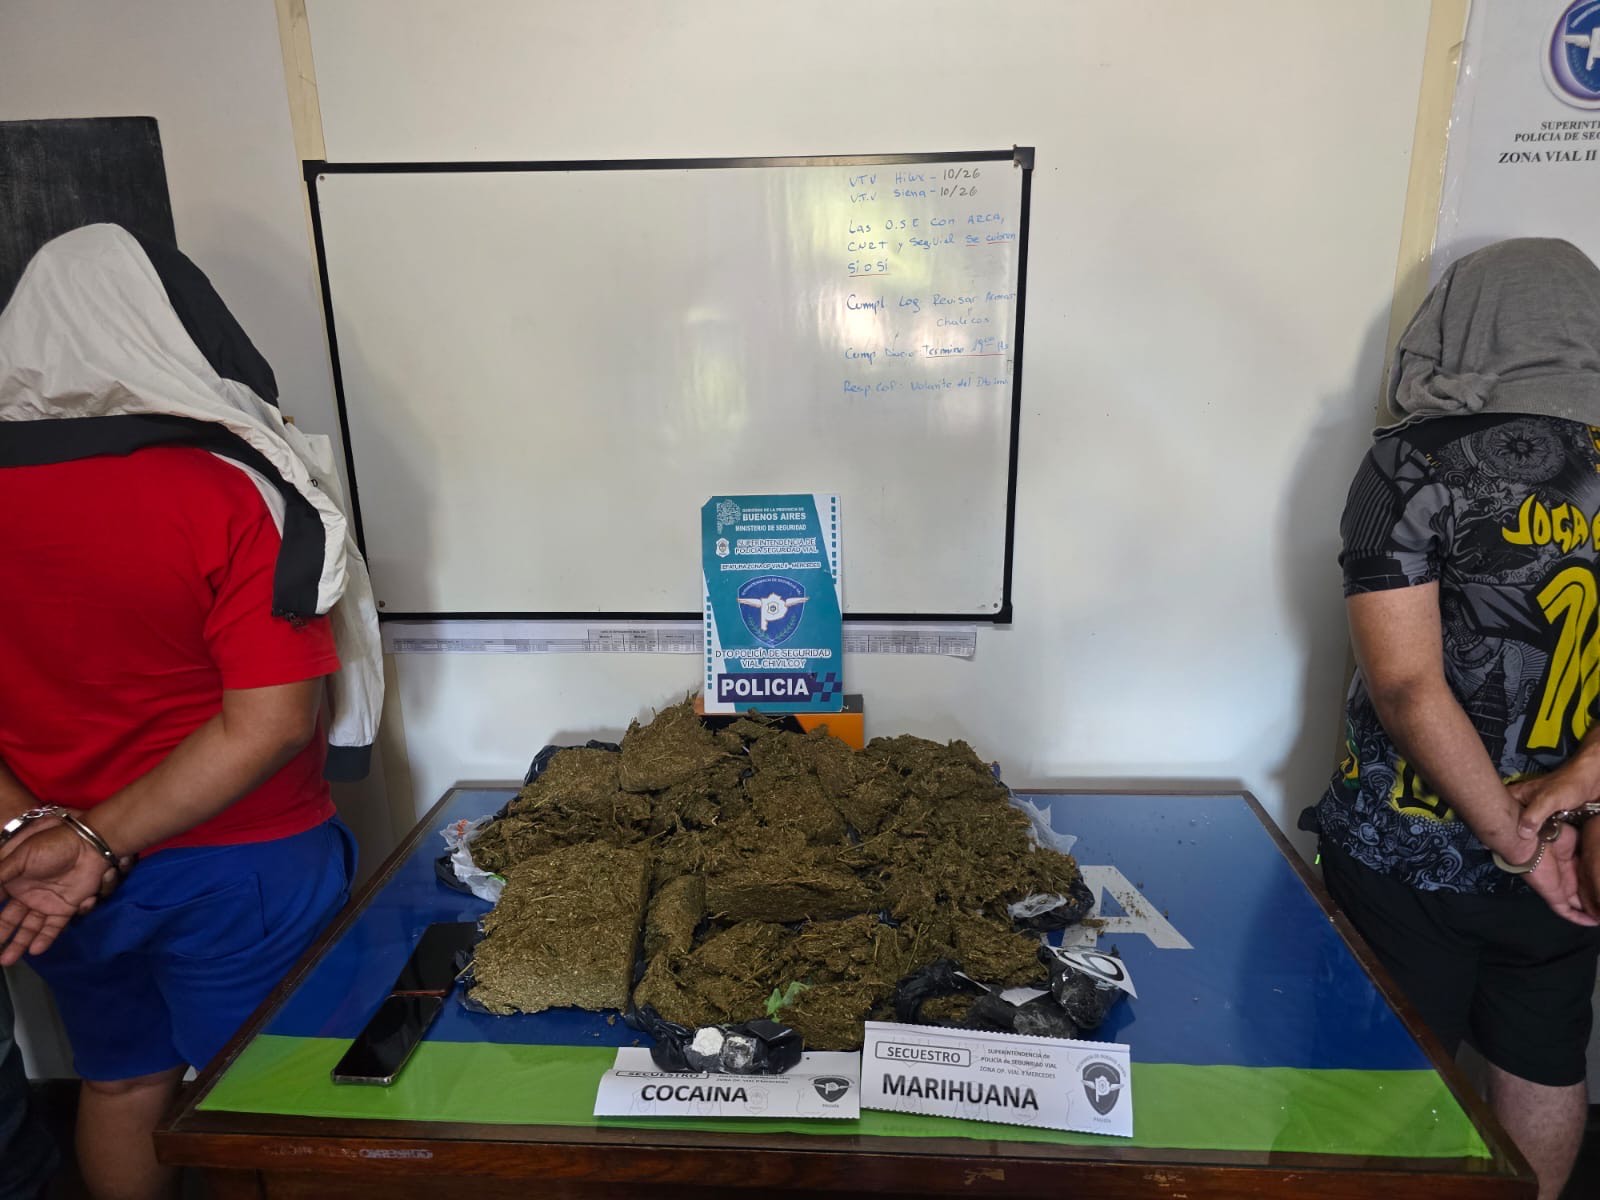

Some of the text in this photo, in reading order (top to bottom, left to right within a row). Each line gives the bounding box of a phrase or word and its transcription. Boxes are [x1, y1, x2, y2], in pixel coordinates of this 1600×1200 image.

[1514, 132, 1561, 142] POLICIA
[1564, 132, 1579, 141] DE
[1498, 150, 1598, 164] ZONA VIAL II
[943, 168, 980, 180] 10/26
[940, 186, 978, 198] 10/26
[849, 220, 871, 234] Las
[897, 242, 903, 254] y
[782, 649, 831, 657] SEGURIDAD
[722, 678, 809, 696] POLICIA
[887, 1046, 961, 1064] SECUESTRO
[641, 1084, 748, 1102] COCAINA
[882, 1073, 1040, 1110] MARIHUANA
